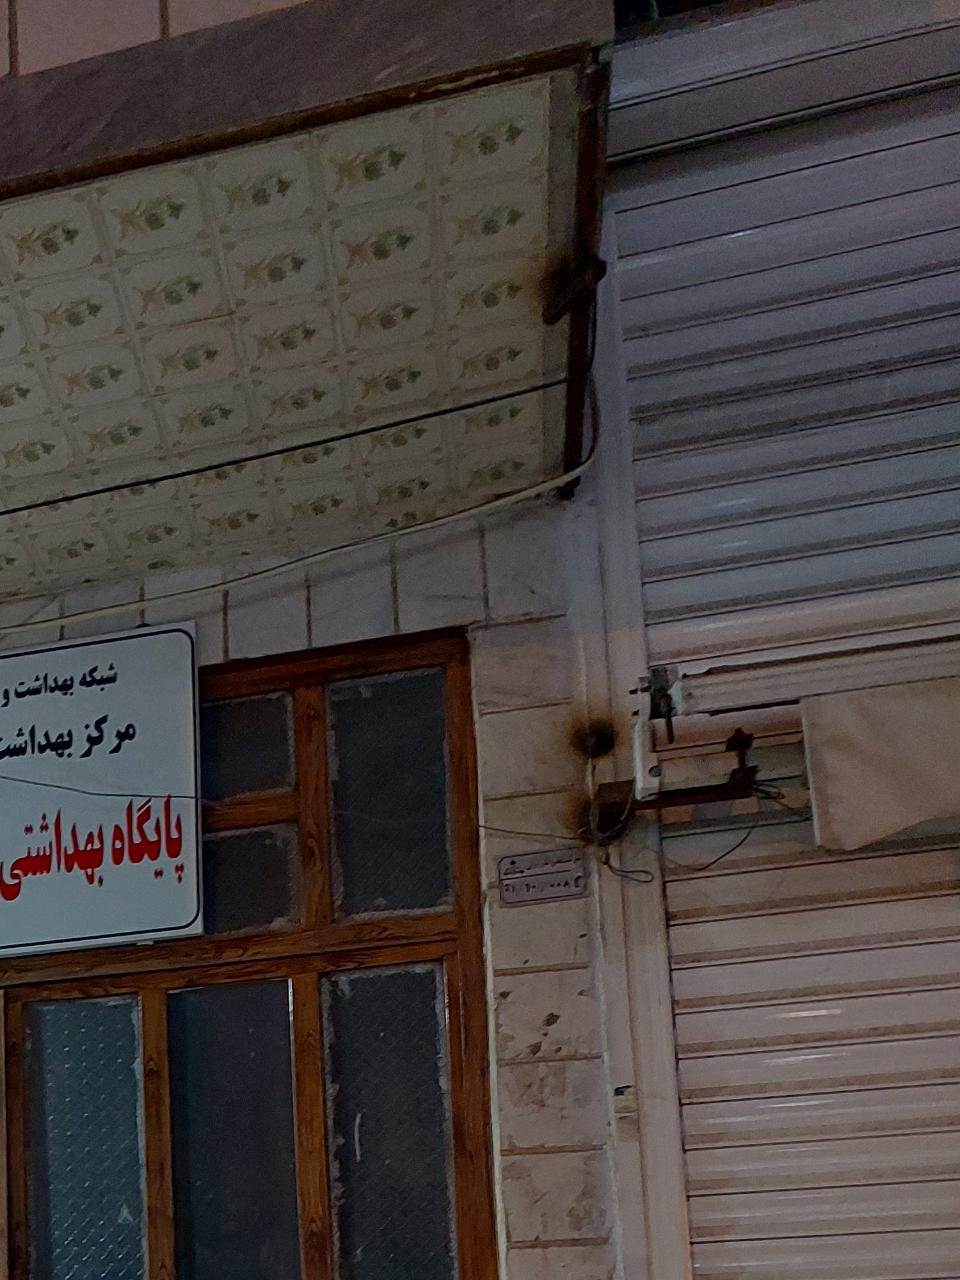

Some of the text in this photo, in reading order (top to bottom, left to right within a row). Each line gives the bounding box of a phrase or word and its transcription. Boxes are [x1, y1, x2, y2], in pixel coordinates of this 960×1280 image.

[14, 672, 75, 698] بهداشت
[79, 662, 118, 692] شبکه
[0, 687, 11, 708] و
[79, 713, 137, 759] مرکز
[111, 794, 185, 884] پایگاه
